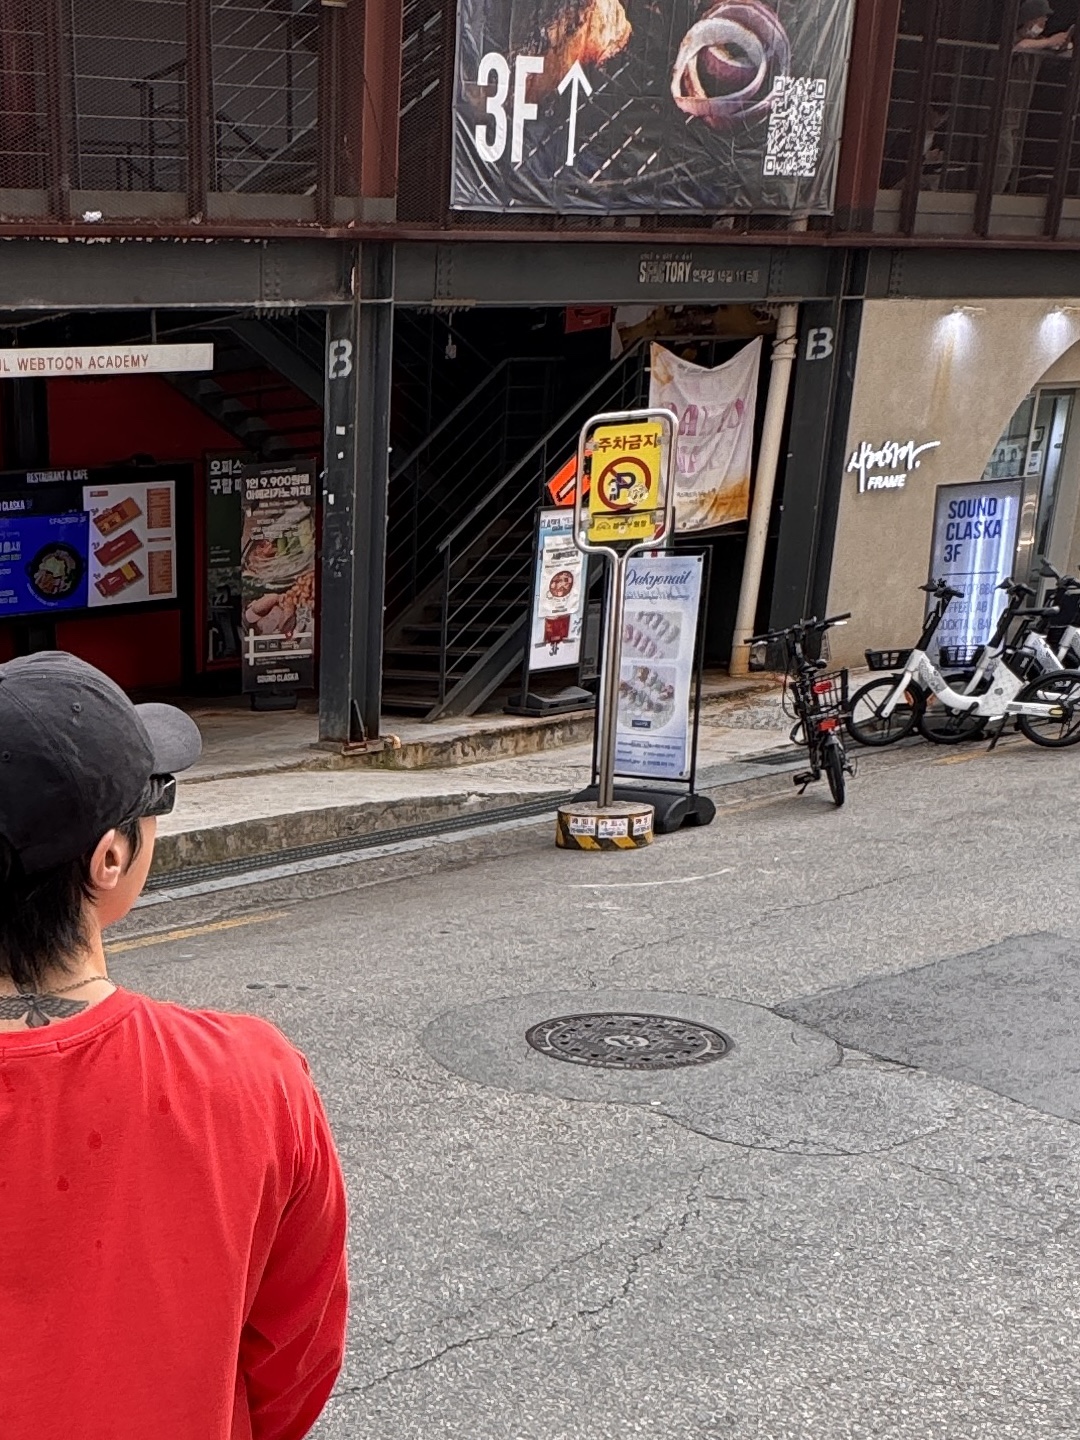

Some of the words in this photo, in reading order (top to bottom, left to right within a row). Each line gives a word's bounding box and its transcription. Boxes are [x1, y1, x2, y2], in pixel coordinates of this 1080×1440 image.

[475, 52, 544, 163] 3F
[806, 326, 833, 360] B
[17, 357, 83, 371] WEBTOON
[88, 354, 149, 369] ACADEMY
[329, 339, 352, 379] B
[599, 433, 658, 453] 주차금지
[867, 474, 907, 490] FRAME
[948, 498, 997, 519] SOUND
[945, 519, 1001, 541] CLASKA
[944, 544, 962, 562] 3F
